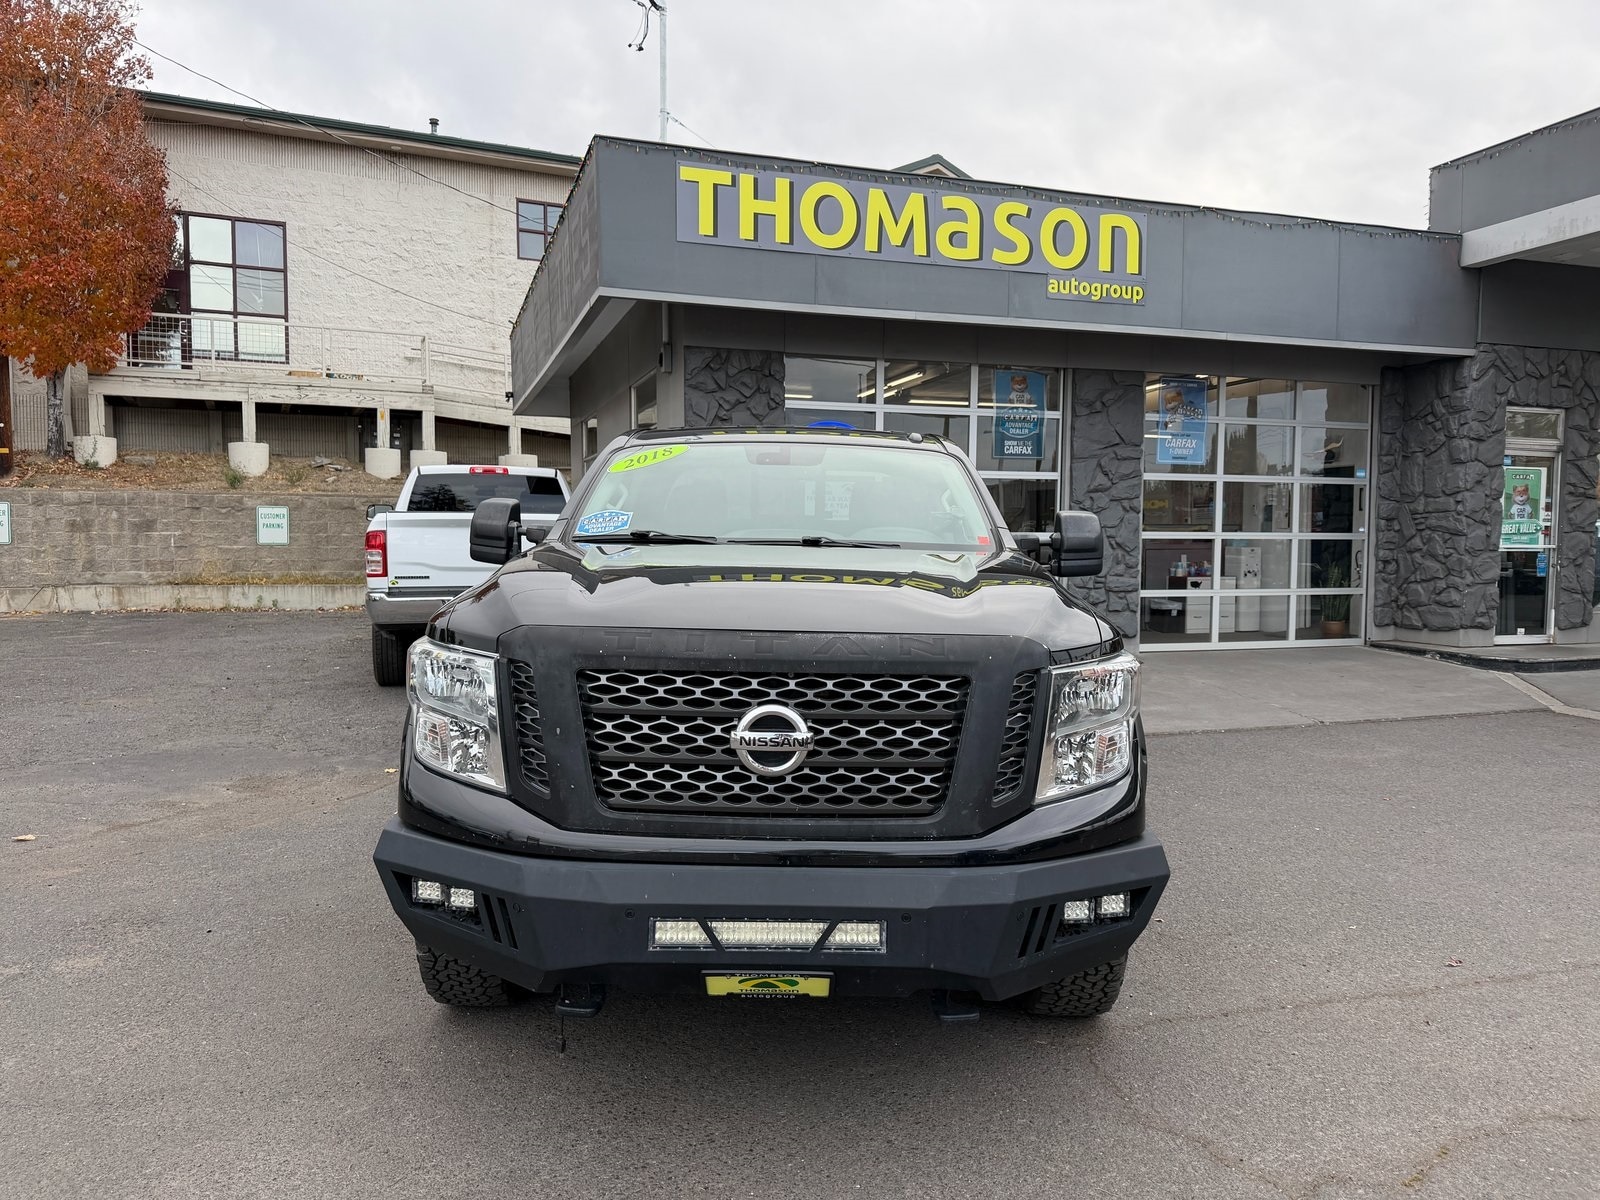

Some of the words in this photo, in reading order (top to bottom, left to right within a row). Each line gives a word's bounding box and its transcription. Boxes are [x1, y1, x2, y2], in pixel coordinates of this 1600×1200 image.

[1047, 277, 1145, 303] autogroup
[1165, 438, 1197, 448] CARFAX
[1004, 445, 1033, 454] CARFAX
[623, 447, 674, 469] 2018
[1501, 524, 1519, 534] GREAT
[1520, 523, 1536, 533] VALUE
[604, 630, 950, 657] TITAN
[739, 736, 804, 747] NISSAN
